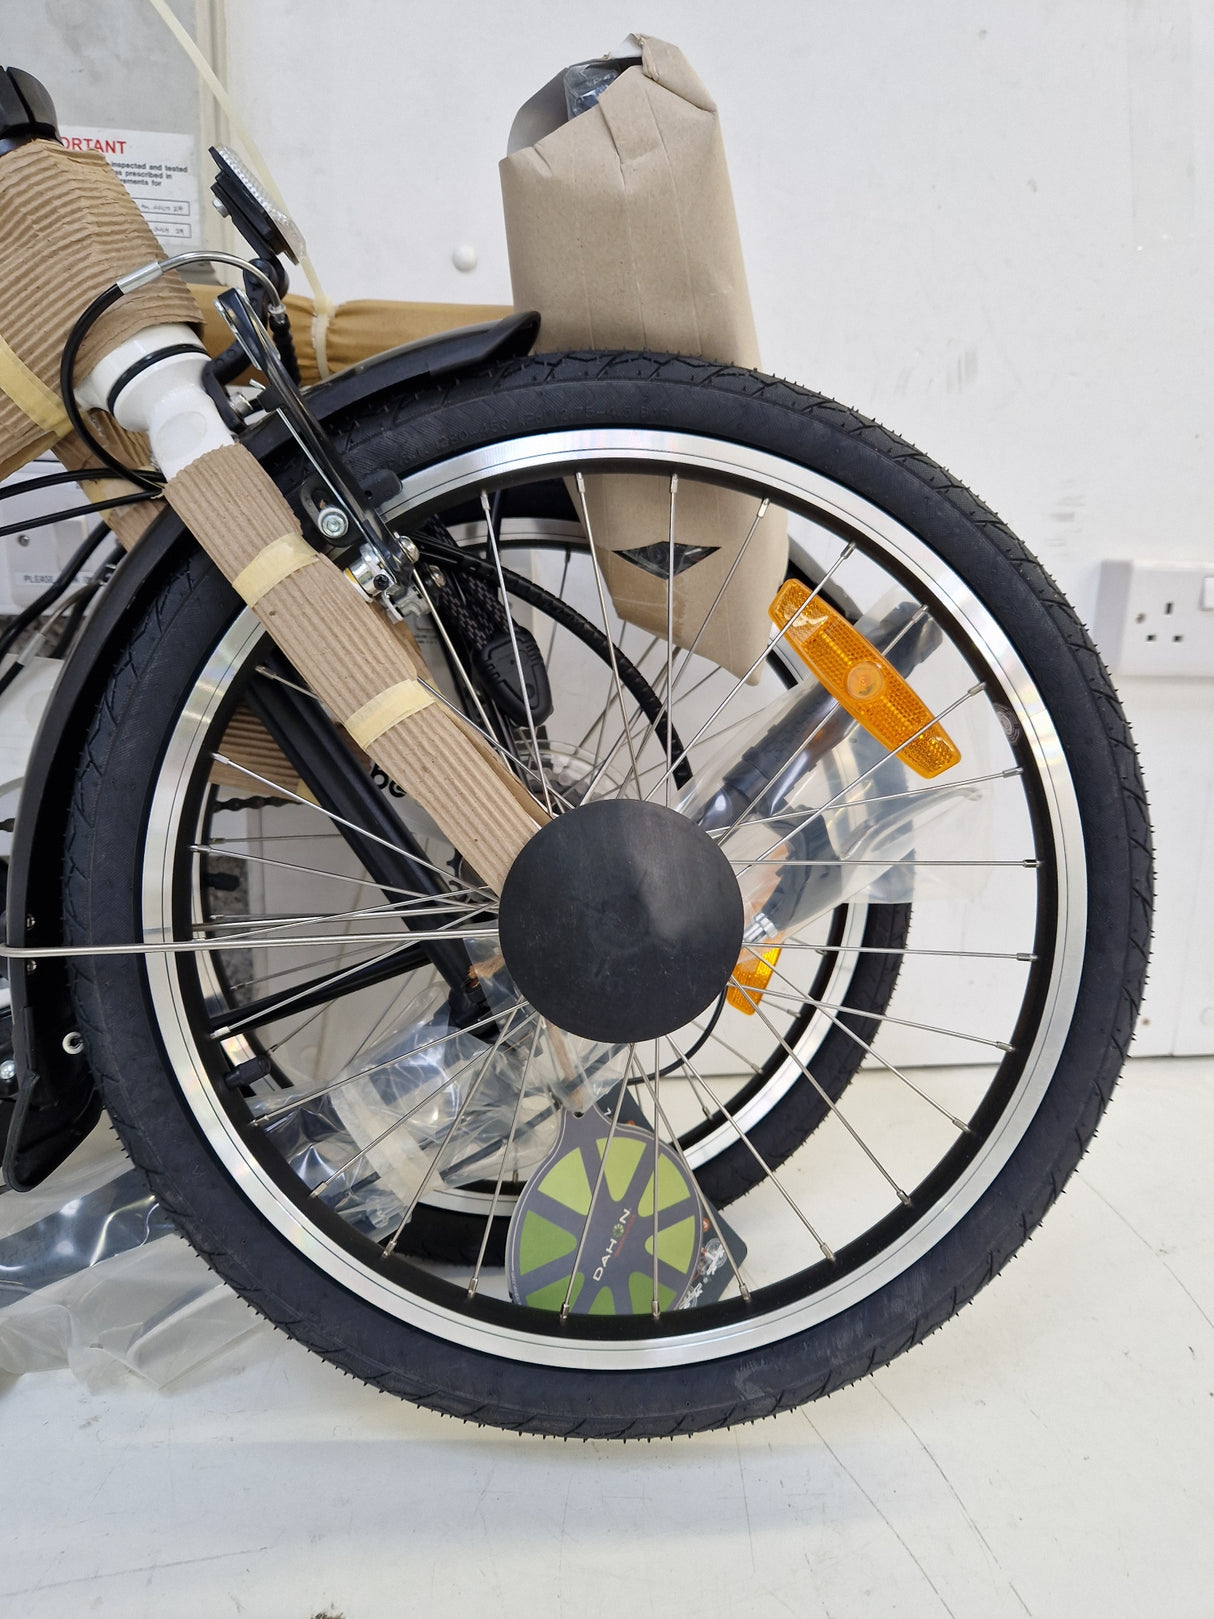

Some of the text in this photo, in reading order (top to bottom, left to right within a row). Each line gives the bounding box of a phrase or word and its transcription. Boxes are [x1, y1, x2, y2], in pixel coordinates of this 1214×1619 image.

[111, 162, 146, 170] inspected
[165, 165, 188, 173] tested
[125, 171, 163, 179] prescribed
[24, 575, 53, 584] PLEASE
[593, 1208, 630, 1281] DAHON
